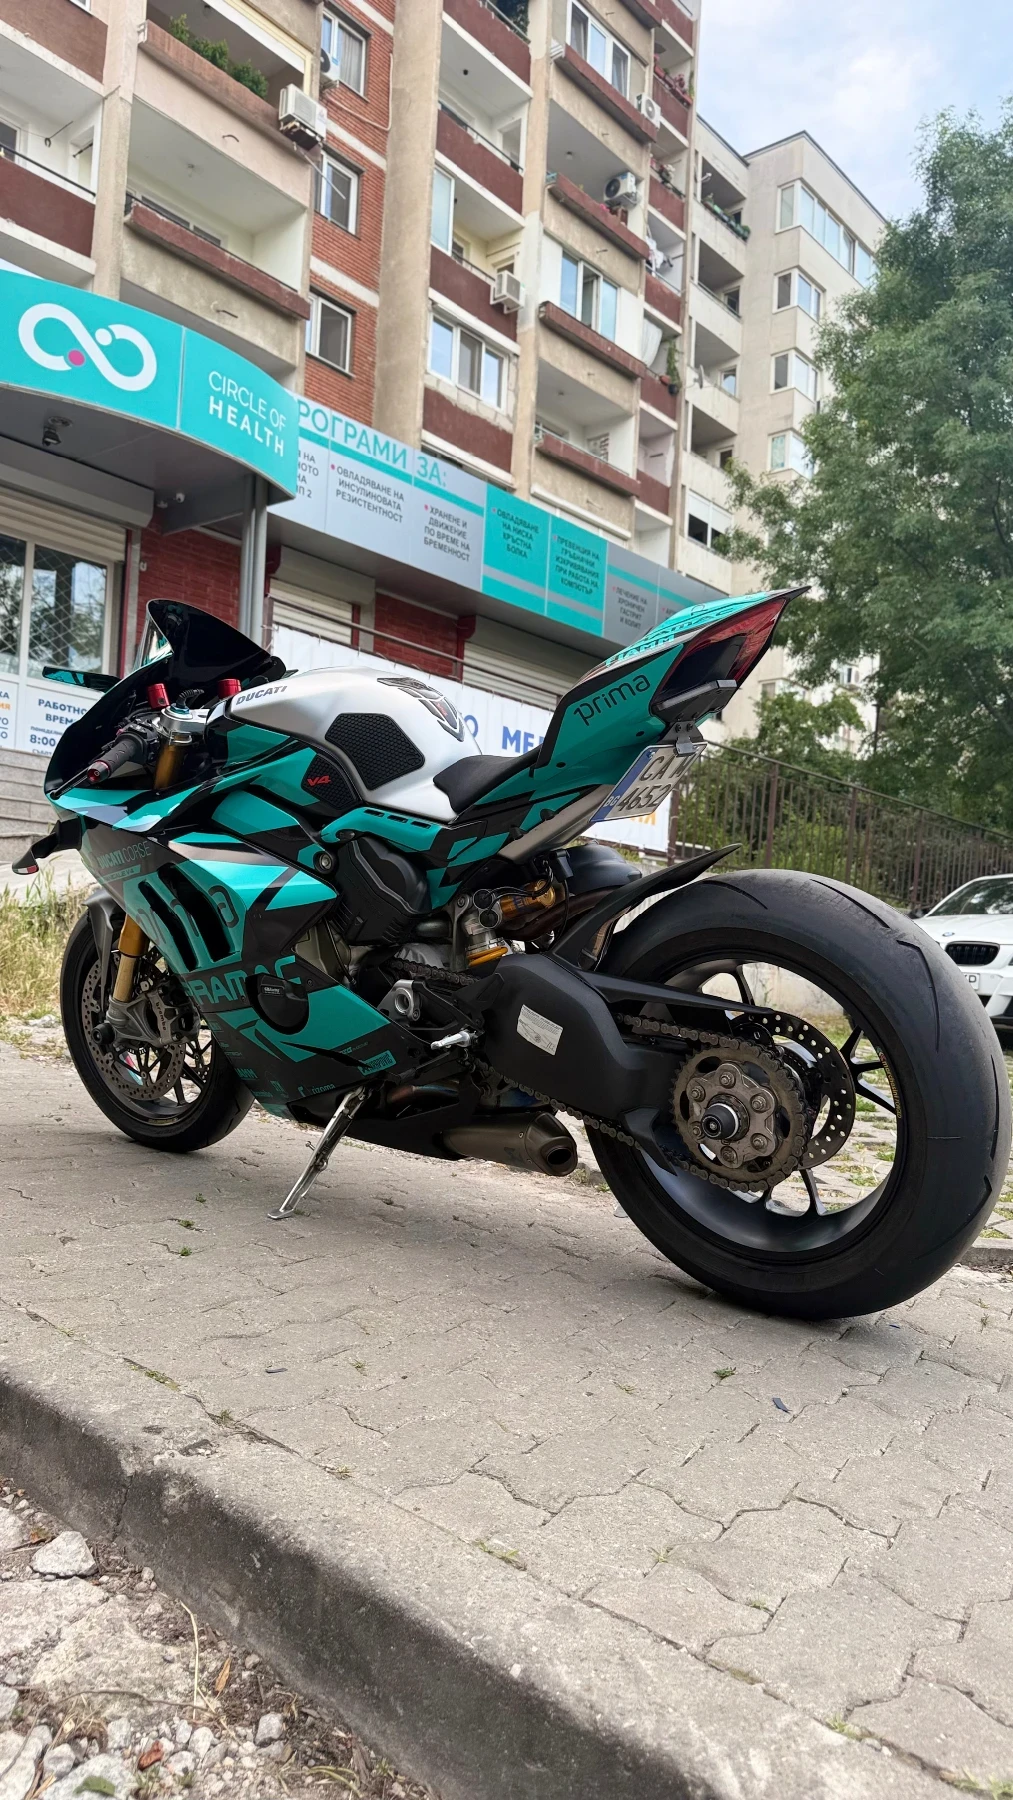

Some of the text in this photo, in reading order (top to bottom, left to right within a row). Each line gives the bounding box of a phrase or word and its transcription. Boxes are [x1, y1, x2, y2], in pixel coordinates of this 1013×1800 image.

[208, 370, 287, 432] CIRCLE OF
[208, 396, 285, 457] HEALTH
[336, 465, 405, 502] ОВЛАДЯВАНЕ НА
[417, 456, 448, 487] ЗА:
[307, 489, 313, 499] 2
[335, 490, 404, 523] РЕЗИСТЕНТНОСТ
[338, 478, 402, 512] ИНСУЛИНОВАТА
[428, 517, 467, 540] ДВИЖЕНИЕ
[429, 506, 468, 530] ХРАНЕНЕ И
[496, 508, 540, 534] ОВЛАДЯВАНЕ
[424, 525, 471, 553] ПО ВРЕМЕ НА
[502, 521, 534, 542] НА НИСКА
[423, 537, 471, 562] БРЕМЕННОСТ
[591, 550, 600, 562] НА
[235, 685, 288, 706] DUCATI
[573, 673, 651, 727] prima
[45, 714, 75, 725] ВРЕМ
[29, 734, 56, 747] 8:00
[502, 726, 545, 753] МЕ
[306, 774, 332, 788] V4
[604, 795, 621, 808] BG
[617, 783, 672, 812] 4652
[97, 840, 152, 869] DUCATI CORSE
[155, 1000, 167, 1031] brembo
[311, 1083, 336, 1095] rizoma
